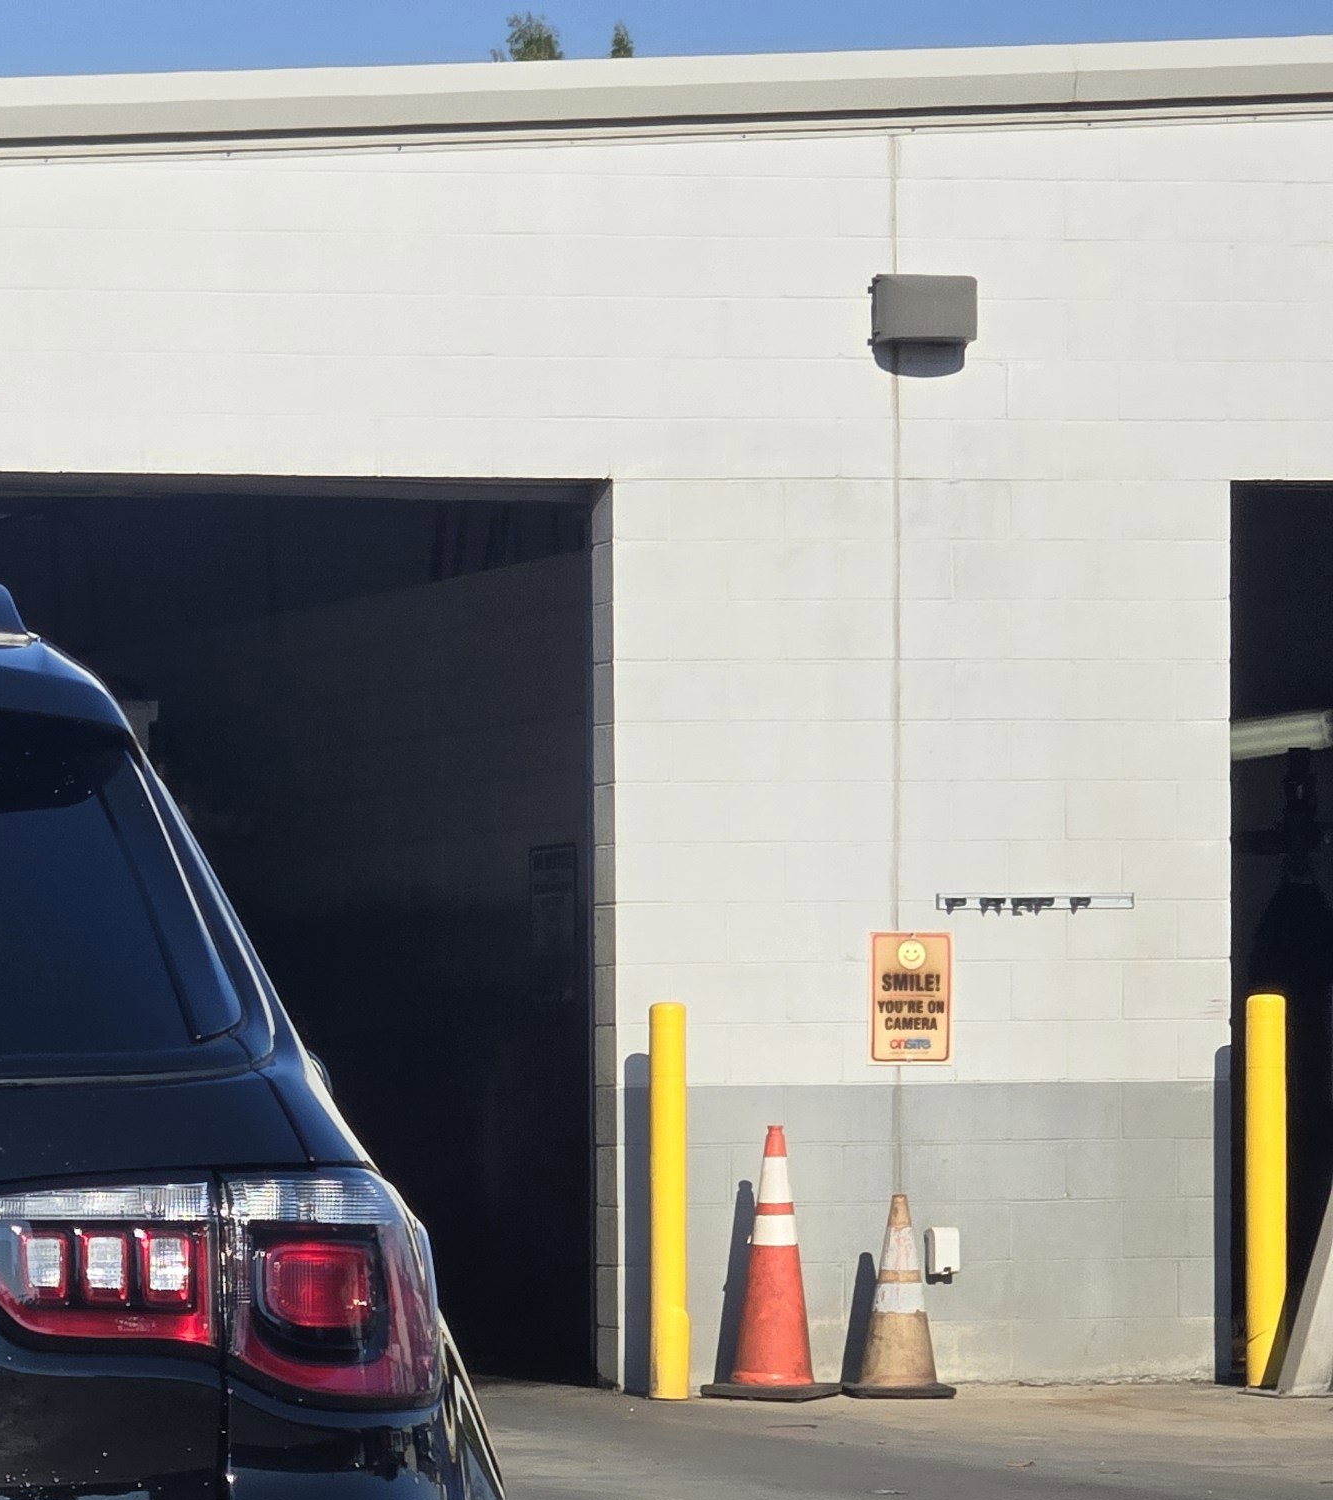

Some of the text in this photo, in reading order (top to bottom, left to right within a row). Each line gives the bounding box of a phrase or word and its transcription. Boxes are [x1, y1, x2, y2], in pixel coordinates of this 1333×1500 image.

[882, 973, 941, 992] SMILE!
[878, 1000, 944, 1014] YOU'RE ON
[884, 1017, 938, 1030] CAMERA
